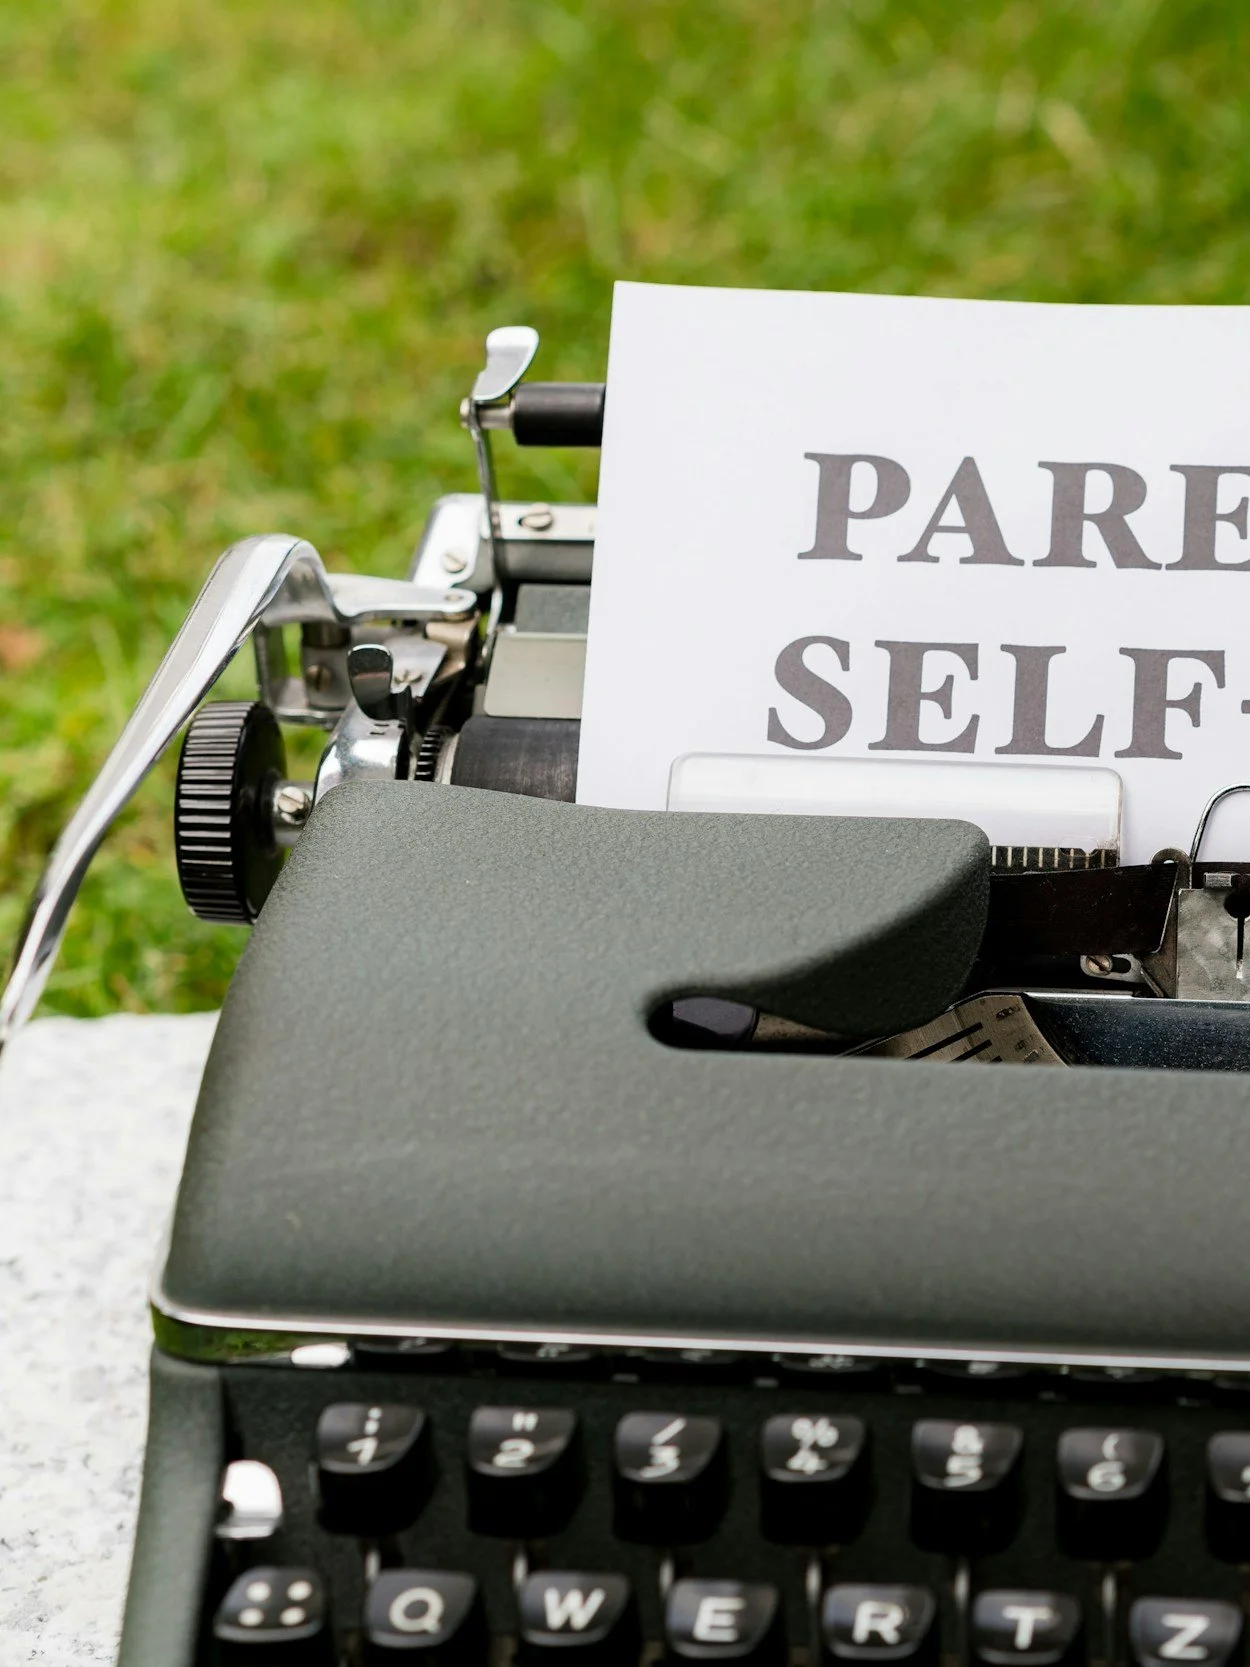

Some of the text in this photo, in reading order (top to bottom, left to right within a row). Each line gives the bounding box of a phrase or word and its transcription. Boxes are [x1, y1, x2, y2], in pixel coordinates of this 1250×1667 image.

[347, 1436, 378, 1468] 1
[492, 1438, 536, 1467] 2
[639, 1444, 682, 1479] 3
[942, 1455, 983, 1488] 5
[1087, 1460, 1127, 1493] 6
[390, 1587, 444, 1634] Q
[544, 1588, 606, 1630] W
[695, 1598, 744, 1642] E
[851, 1601, 904, 1645] R
[1002, 1606, 1049, 1650] T
[1160, 1614, 1209, 1660] Z
